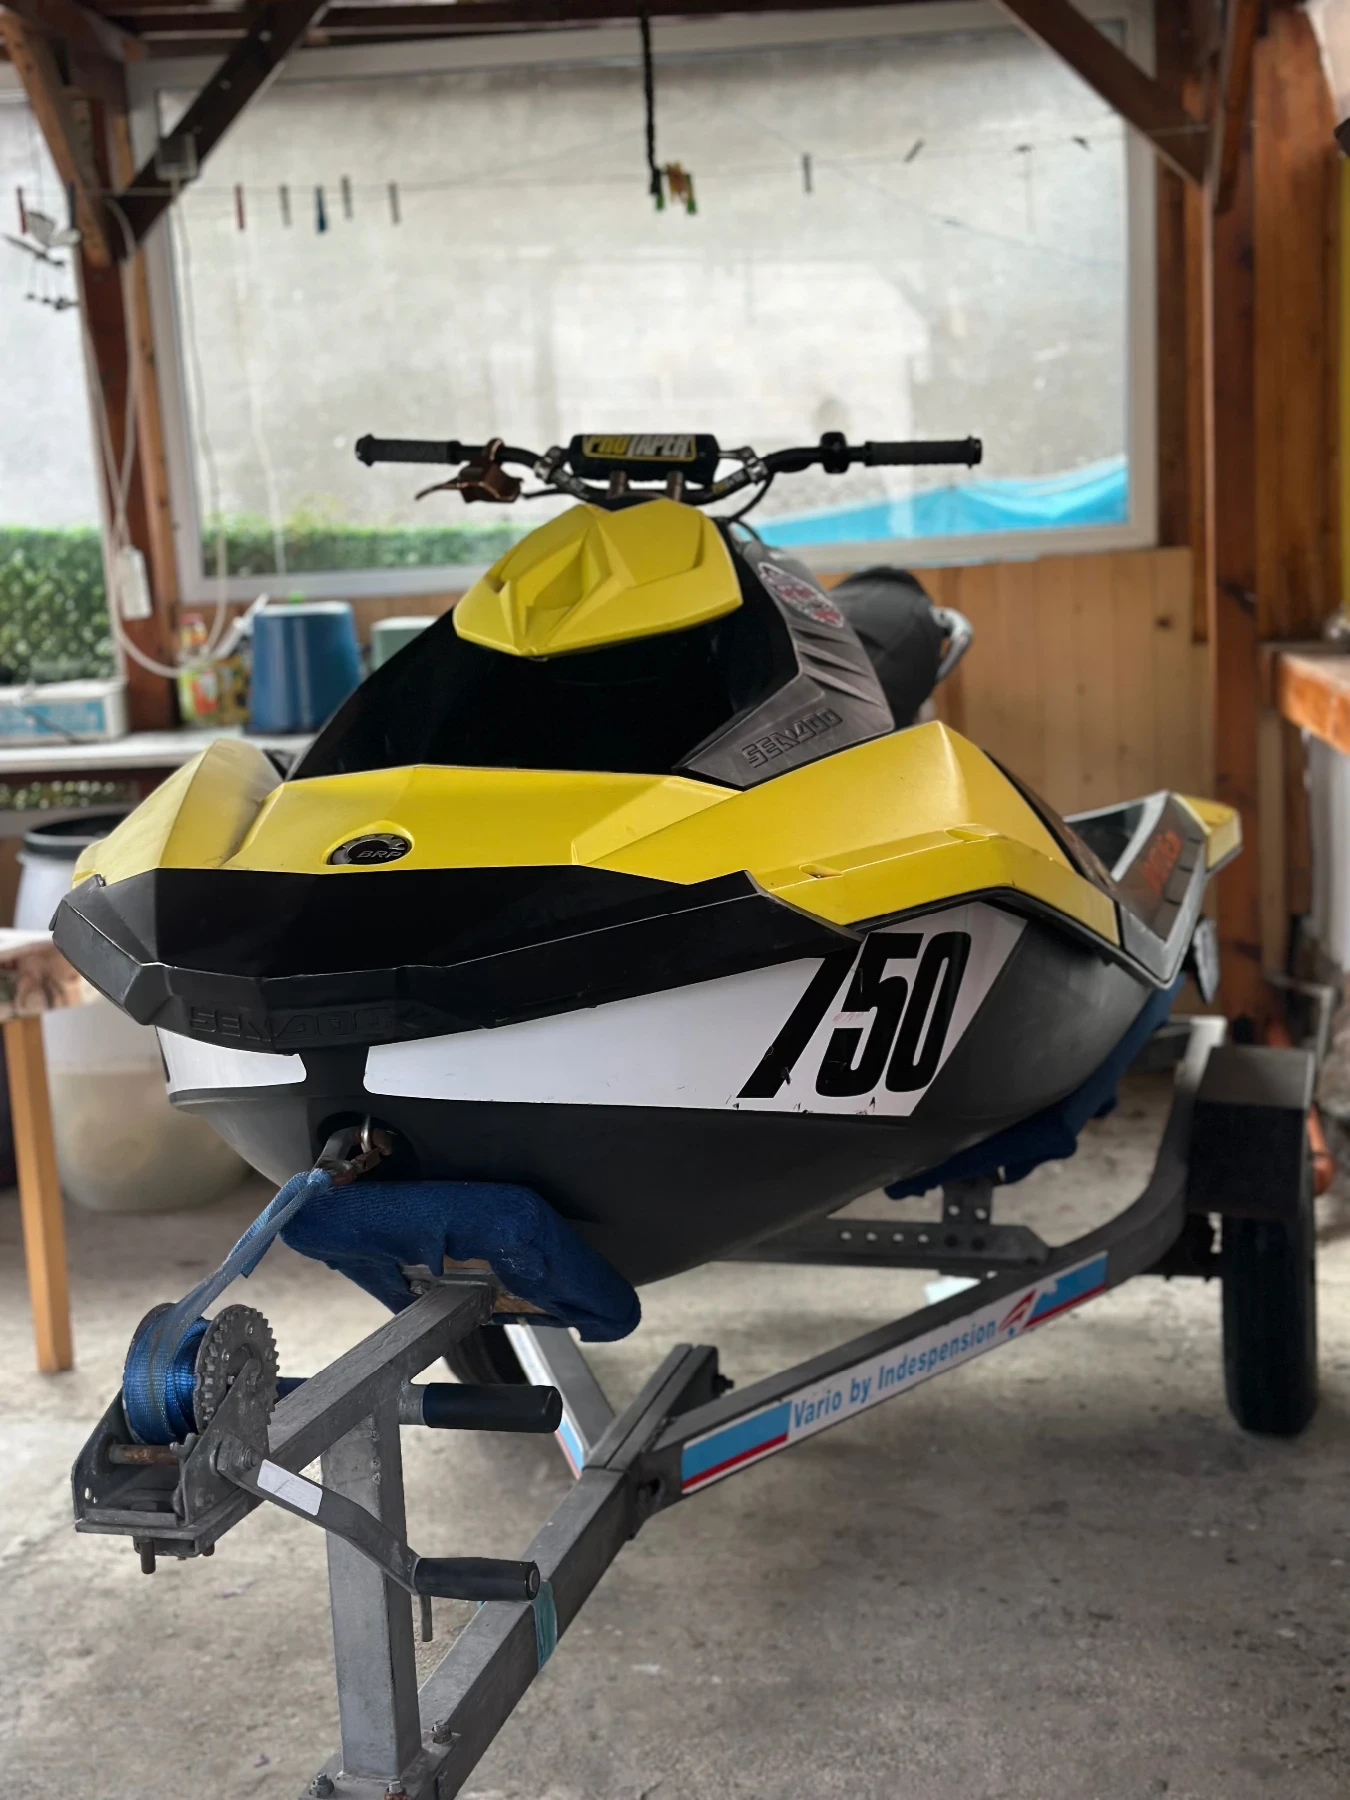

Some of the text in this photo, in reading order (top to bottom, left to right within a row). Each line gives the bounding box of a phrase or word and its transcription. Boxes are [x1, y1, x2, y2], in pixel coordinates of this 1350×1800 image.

[356, 850, 402, 859] BRP
[736, 931, 972, 1098] 750
[793, 1319, 996, 1429] Vario by Indespension
